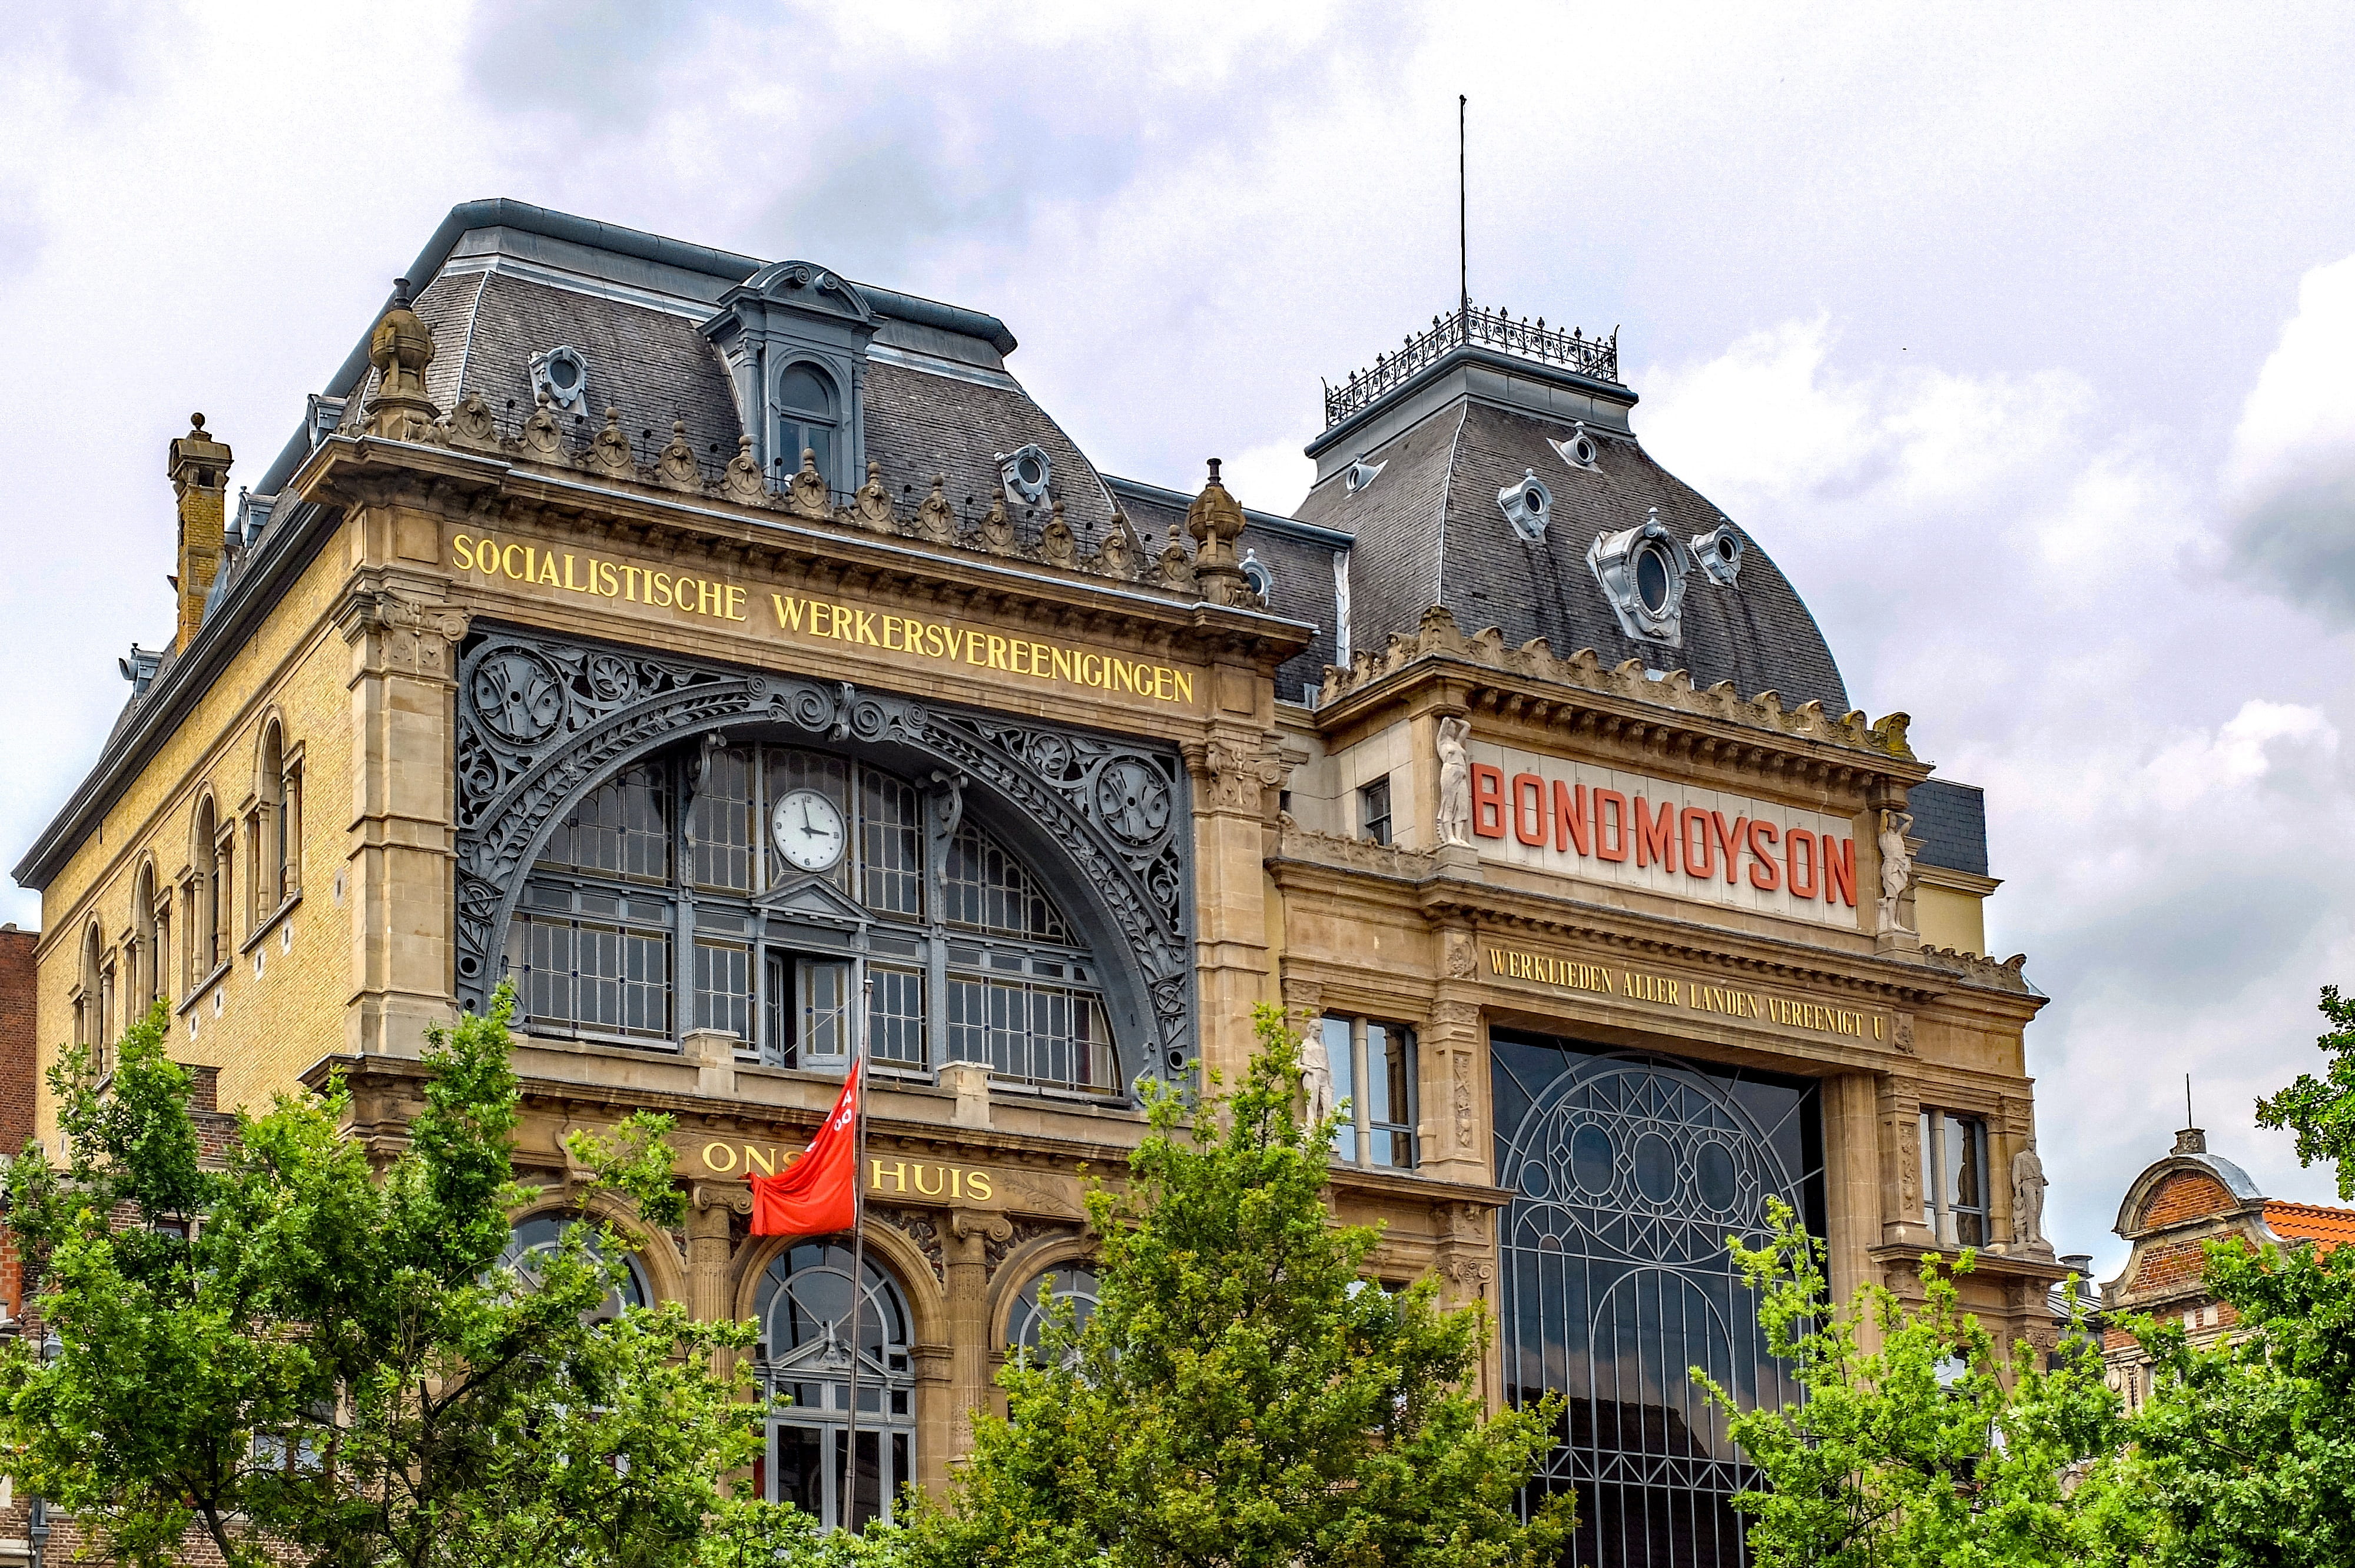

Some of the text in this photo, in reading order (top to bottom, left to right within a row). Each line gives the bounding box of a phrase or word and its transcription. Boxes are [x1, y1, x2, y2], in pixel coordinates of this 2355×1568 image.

[452, 534, 1193, 704] SOCIALISTISCHE WERKERSVEREENIGINGEN
[804, 795, 811, 803] 12
[804, 858, 811, 866] 6
[1471, 762, 1857, 907] BONDMOYSON
[1489, 948, 1885, 1041] WERKLIEDEN ALLER LANDEN VEREENIGT U
[870, 1159, 993, 1201] HUIS
